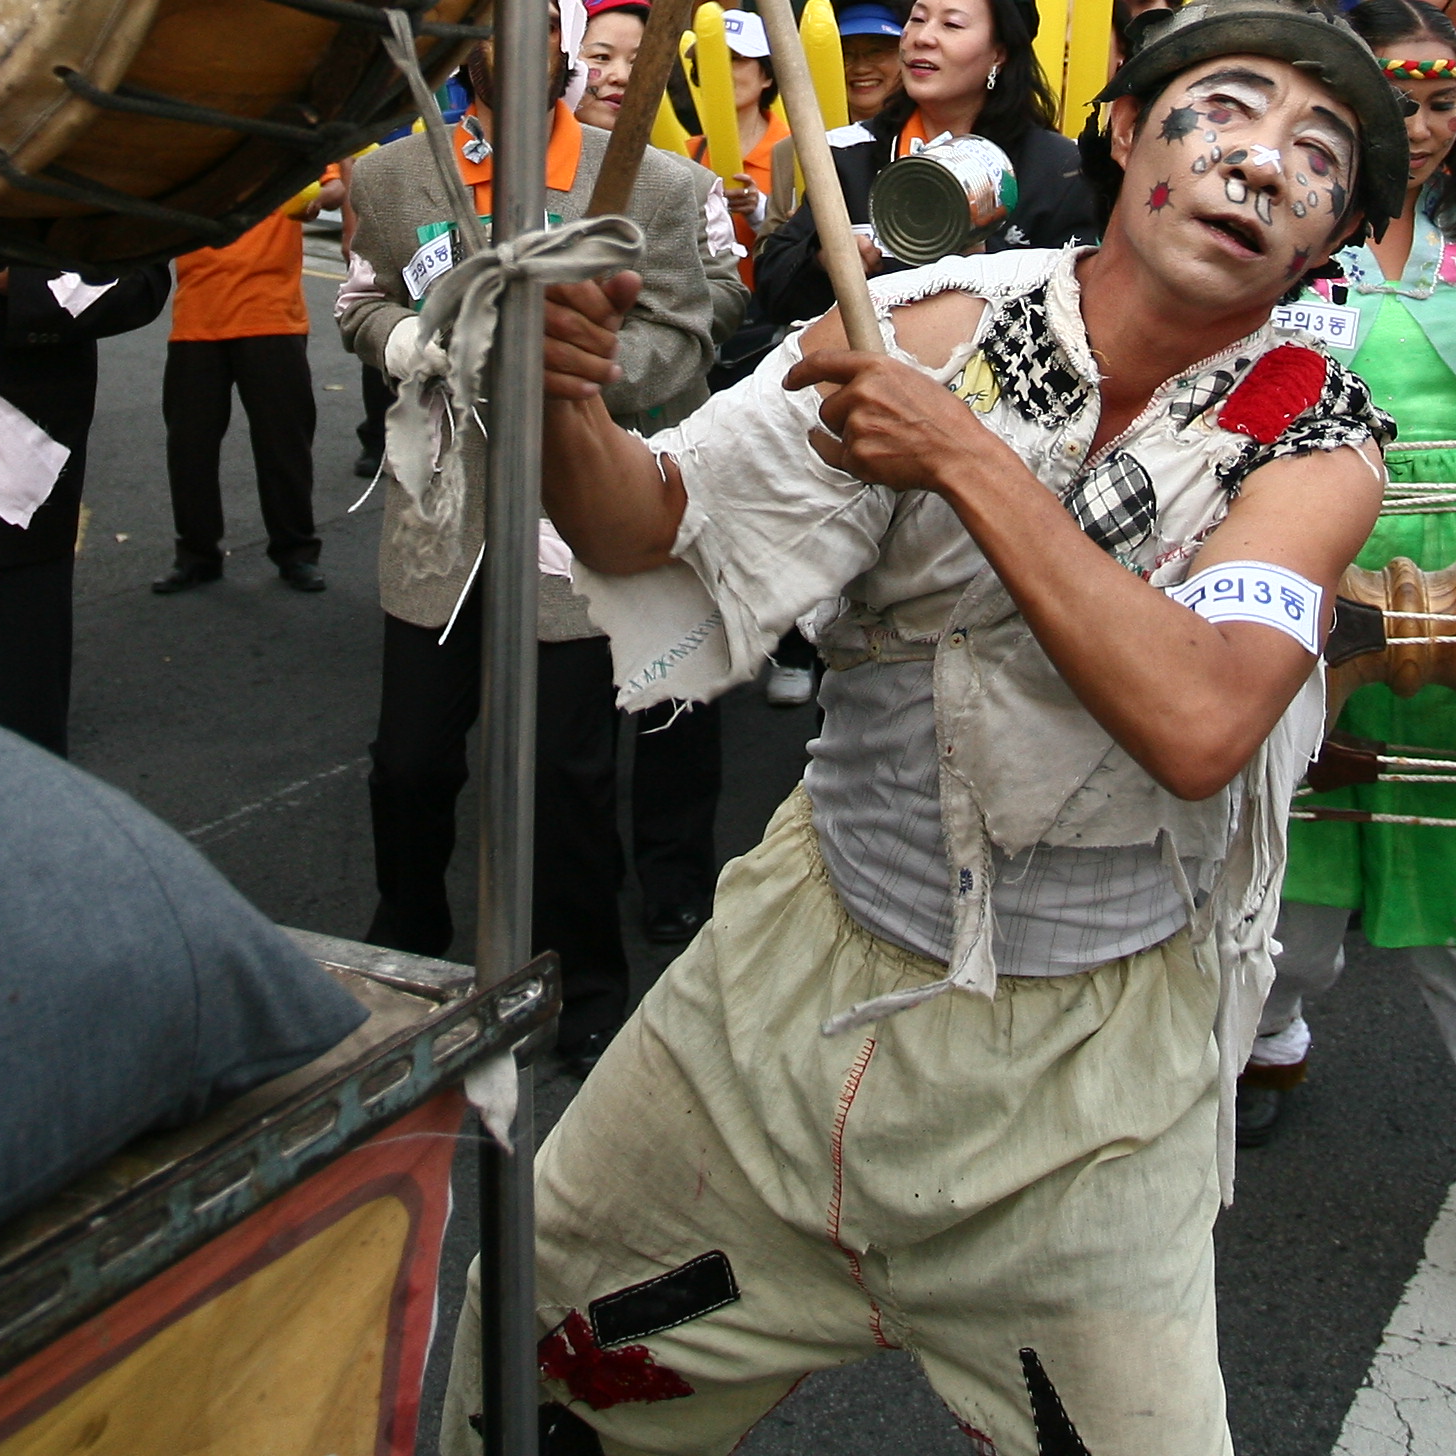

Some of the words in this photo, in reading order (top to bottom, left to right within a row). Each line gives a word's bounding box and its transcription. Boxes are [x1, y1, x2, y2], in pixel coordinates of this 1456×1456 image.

[411, 245, 449, 285] 구의3동
[1276, 307, 1346, 337] 구의3동
[1183, 577, 1306, 622] 구의3동
